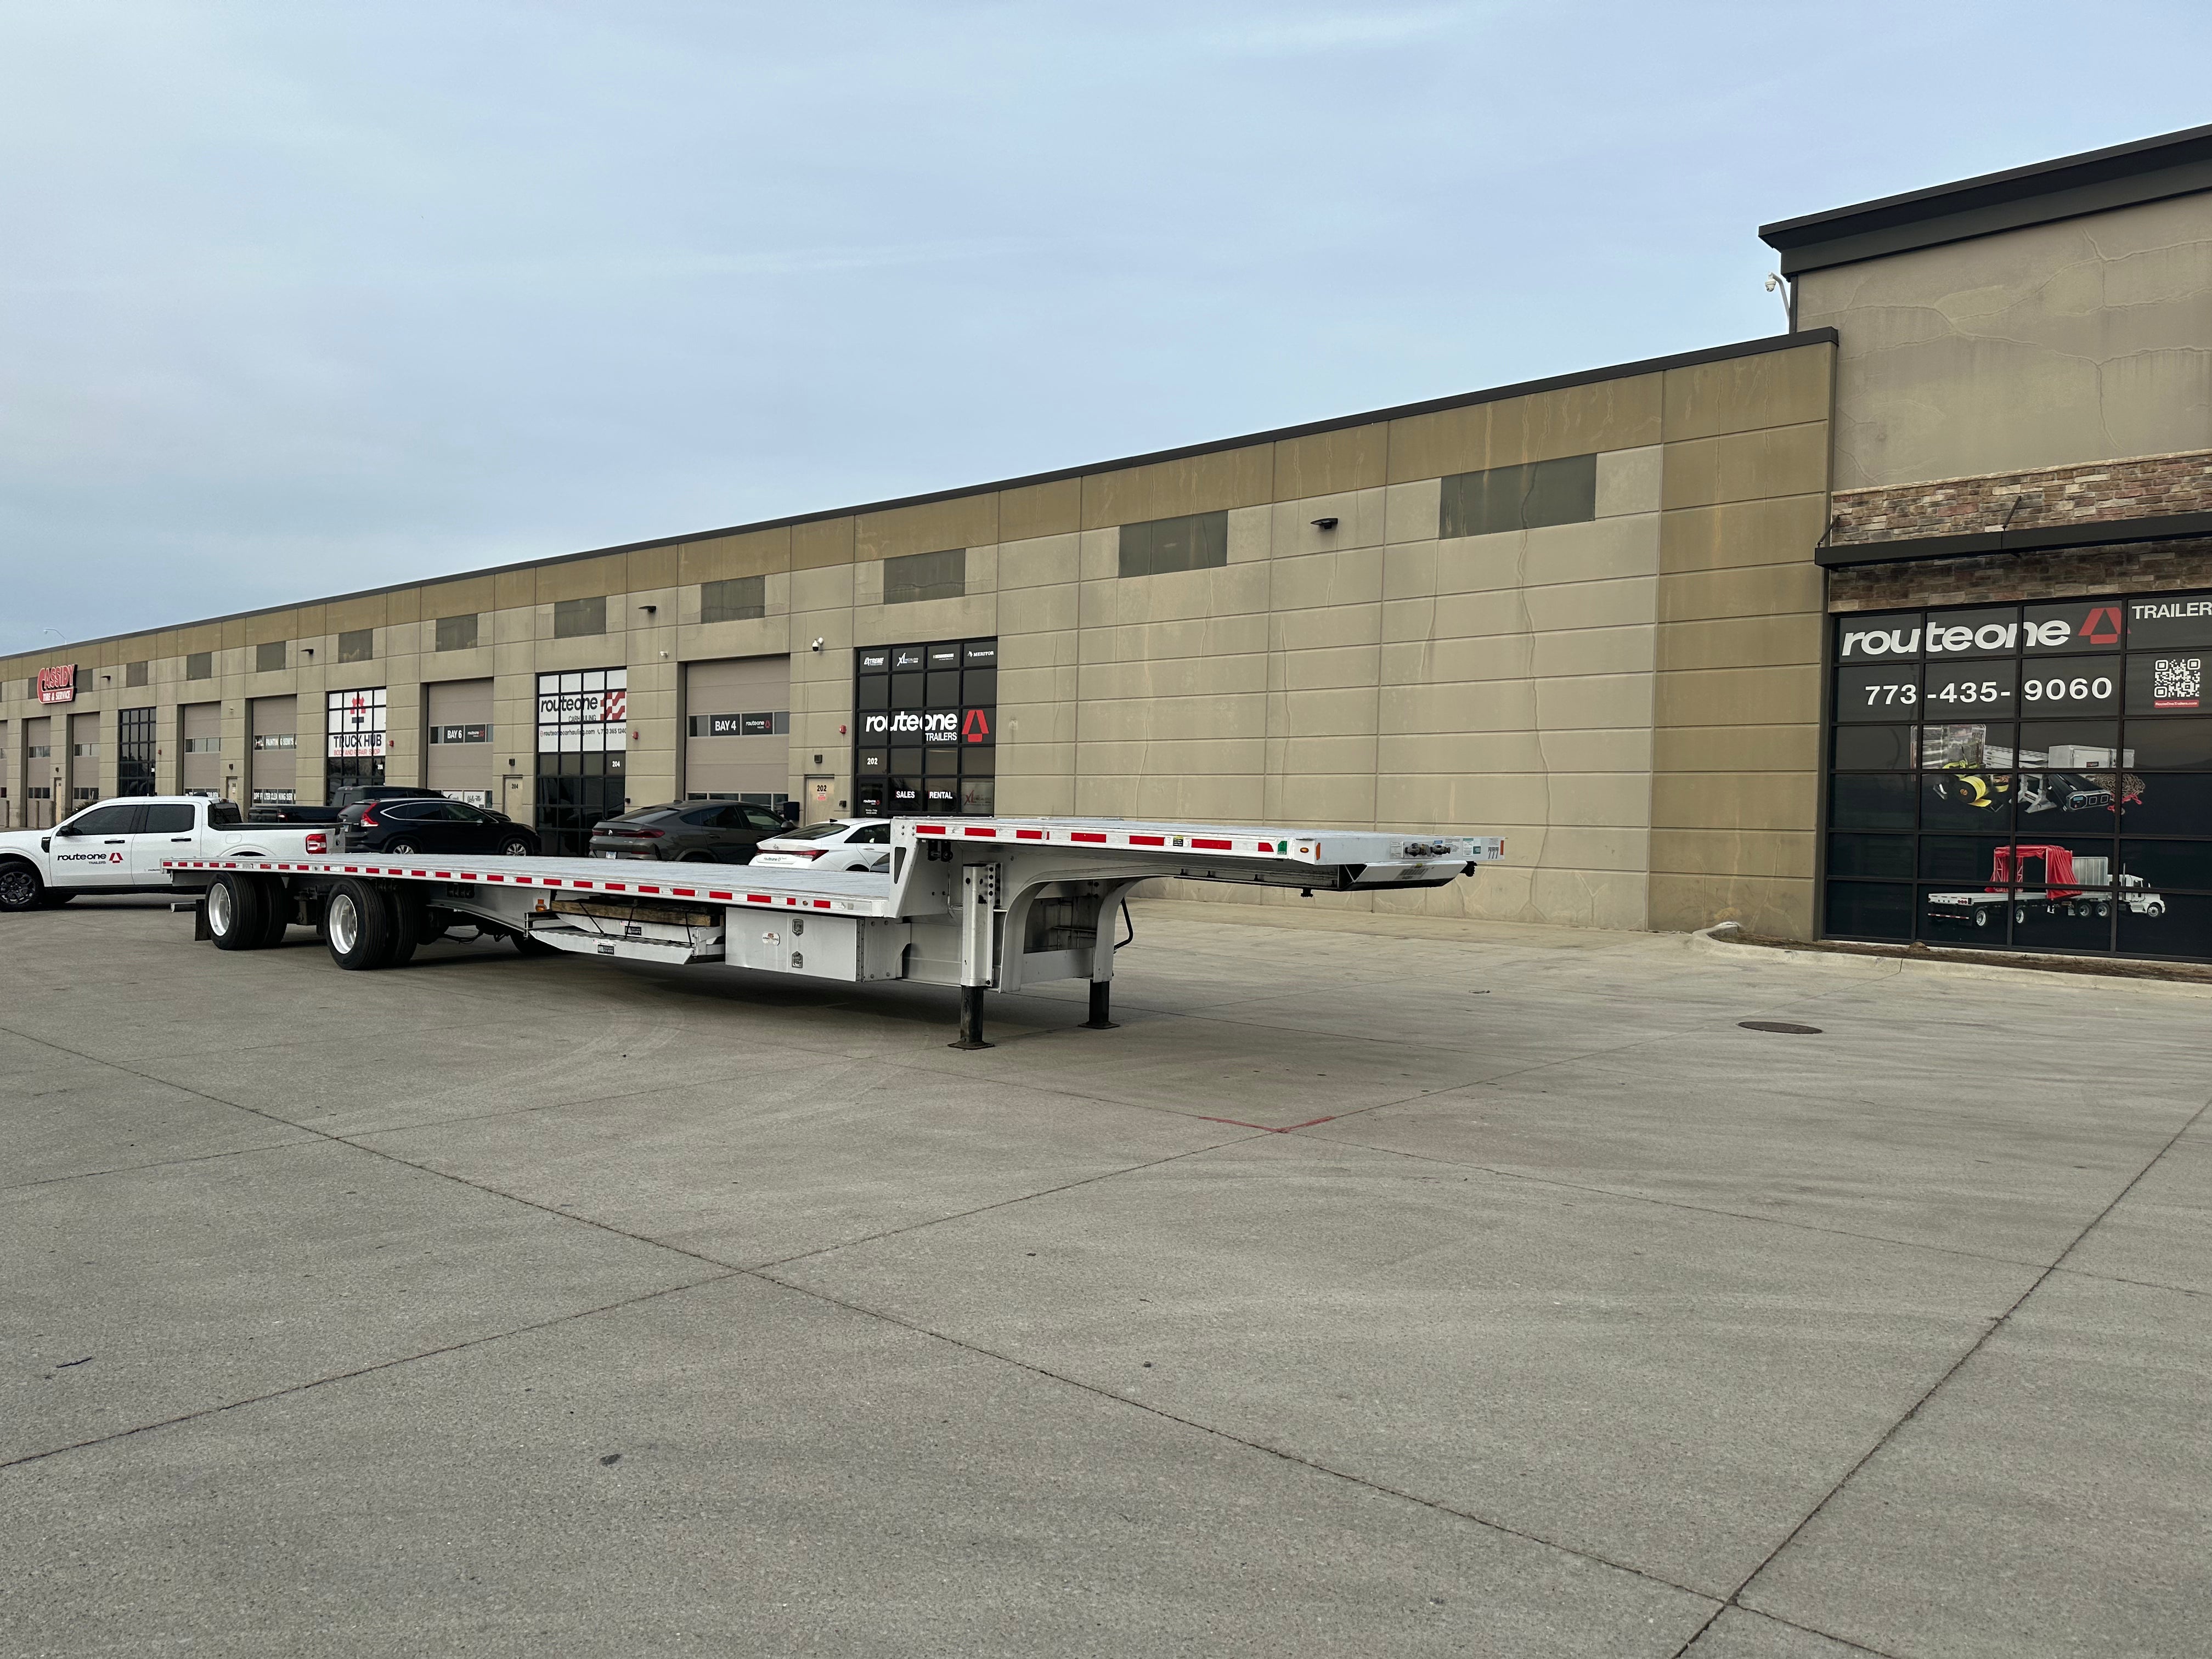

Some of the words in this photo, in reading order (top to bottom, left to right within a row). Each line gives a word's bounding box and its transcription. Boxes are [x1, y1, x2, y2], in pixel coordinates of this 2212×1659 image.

[1842, 620, 2071, 656] routeone
[37, 664, 75, 692] CASSIDY
[55, 691, 70, 700] SERVICE
[540, 696, 597, 712] routeone
[715, 720, 730, 731] BAY
[731, 720, 736, 731] 4
[866, 711, 958, 732] routeone
[334, 735, 363, 748] TRUCK
[364, 734, 382, 747] HUB
[447, 730, 458, 739] BAY
[458, 730, 462, 738] 6
[925, 732, 957, 741] TRAILERS
